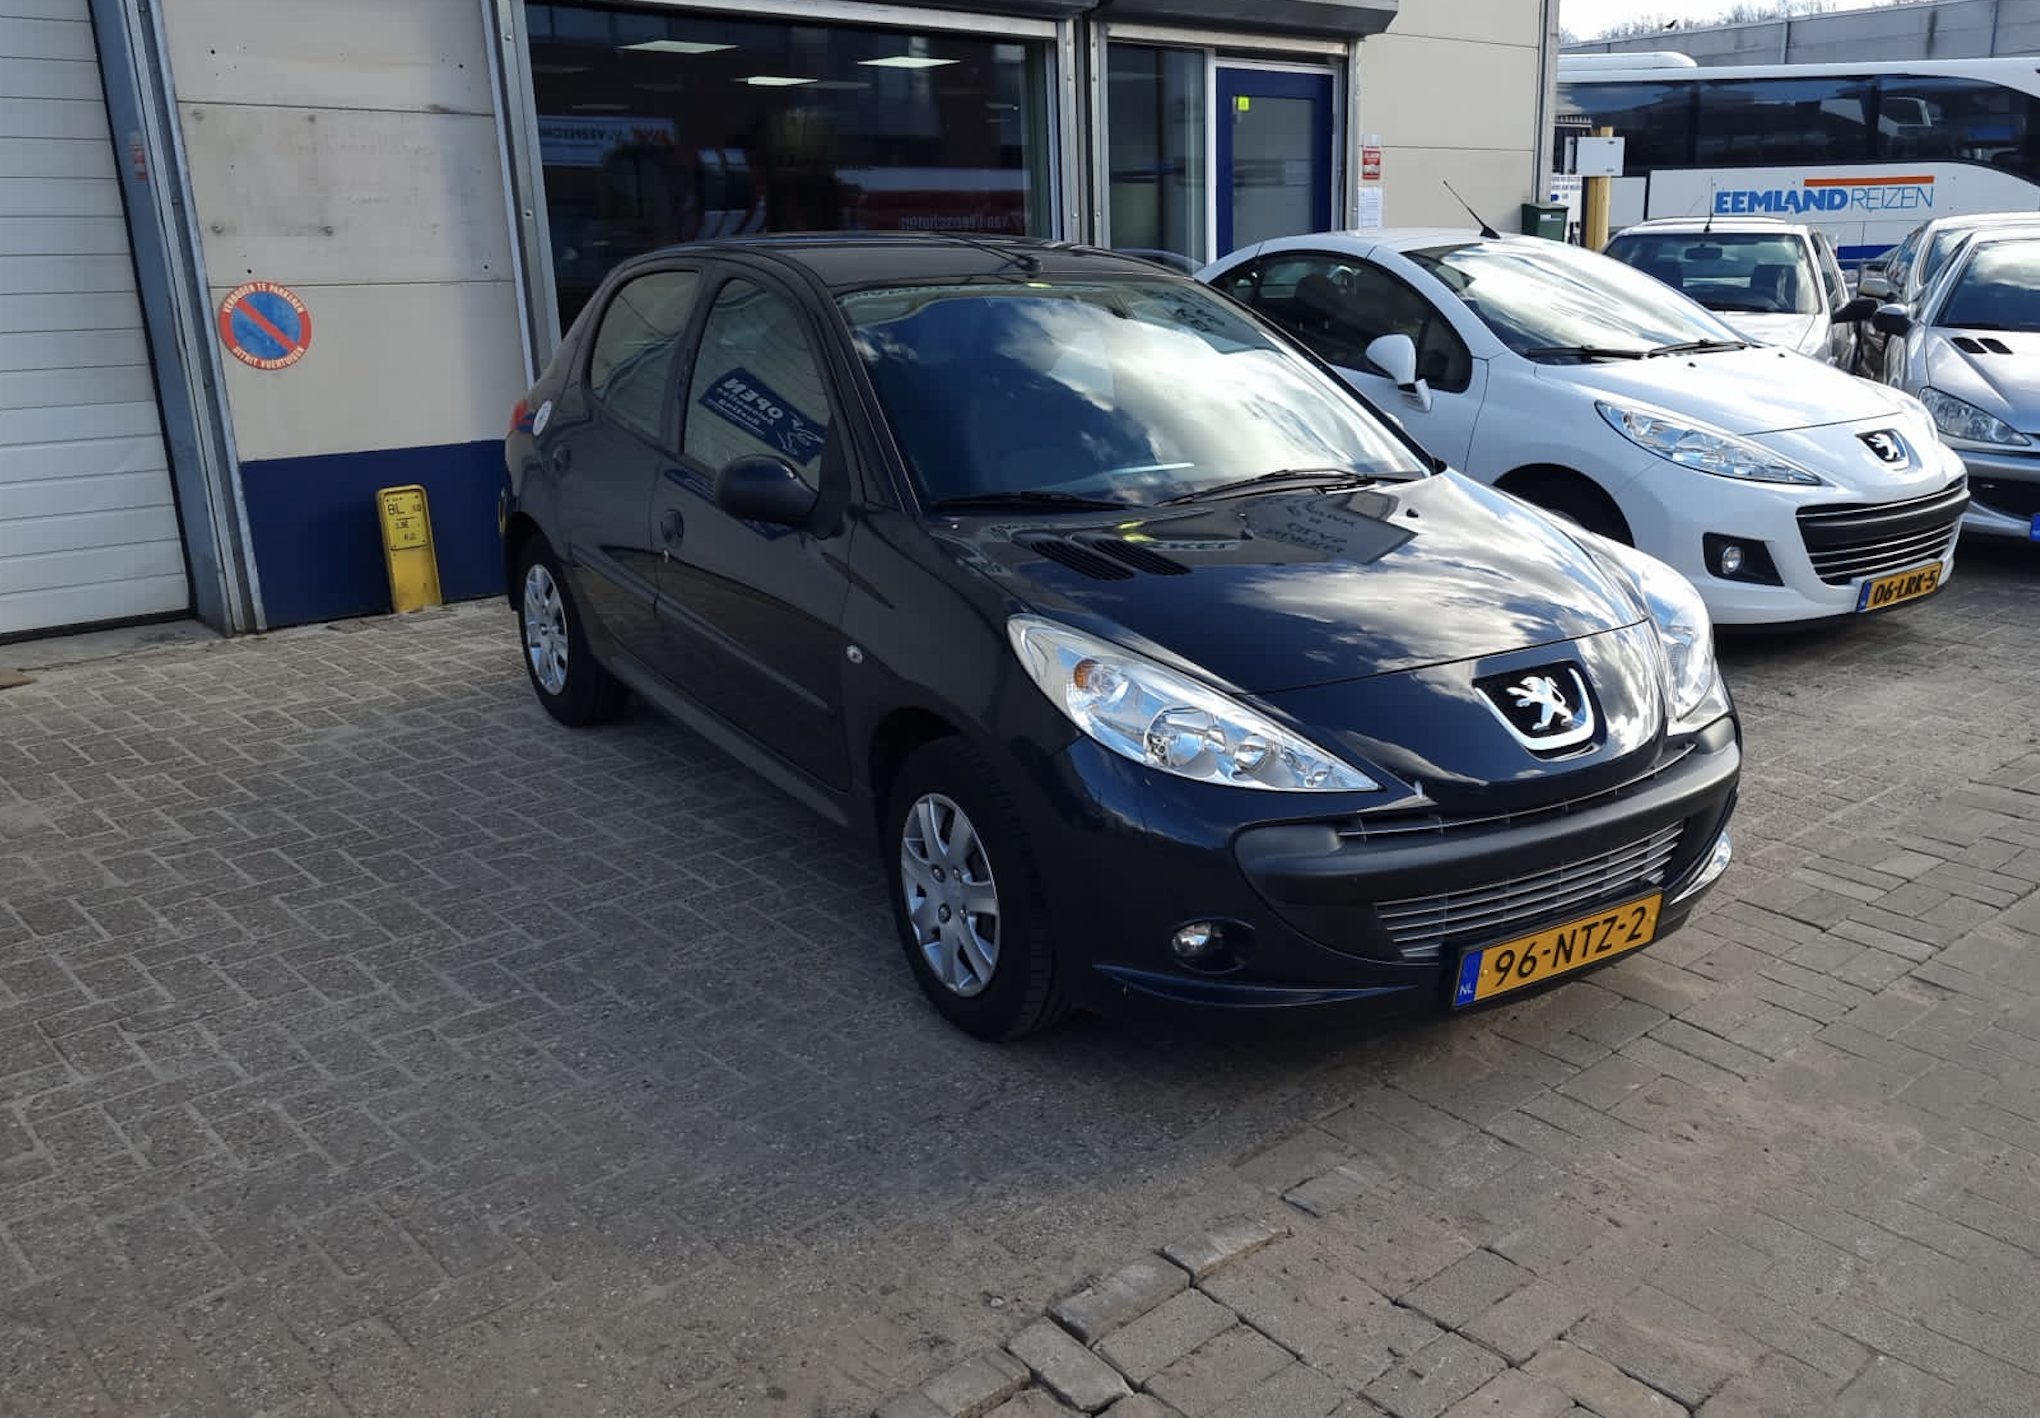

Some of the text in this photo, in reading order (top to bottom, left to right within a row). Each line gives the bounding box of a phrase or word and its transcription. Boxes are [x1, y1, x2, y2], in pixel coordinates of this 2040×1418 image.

[1714, 186, 1935, 214] EEMLAND REIZEN
[256, 282, 268, 293] TE
[268, 283, 305, 313] PARKEREN
[1494, 906, 1647, 987] 96-NTZ-2
[1459, 983, 1473, 996] NL
